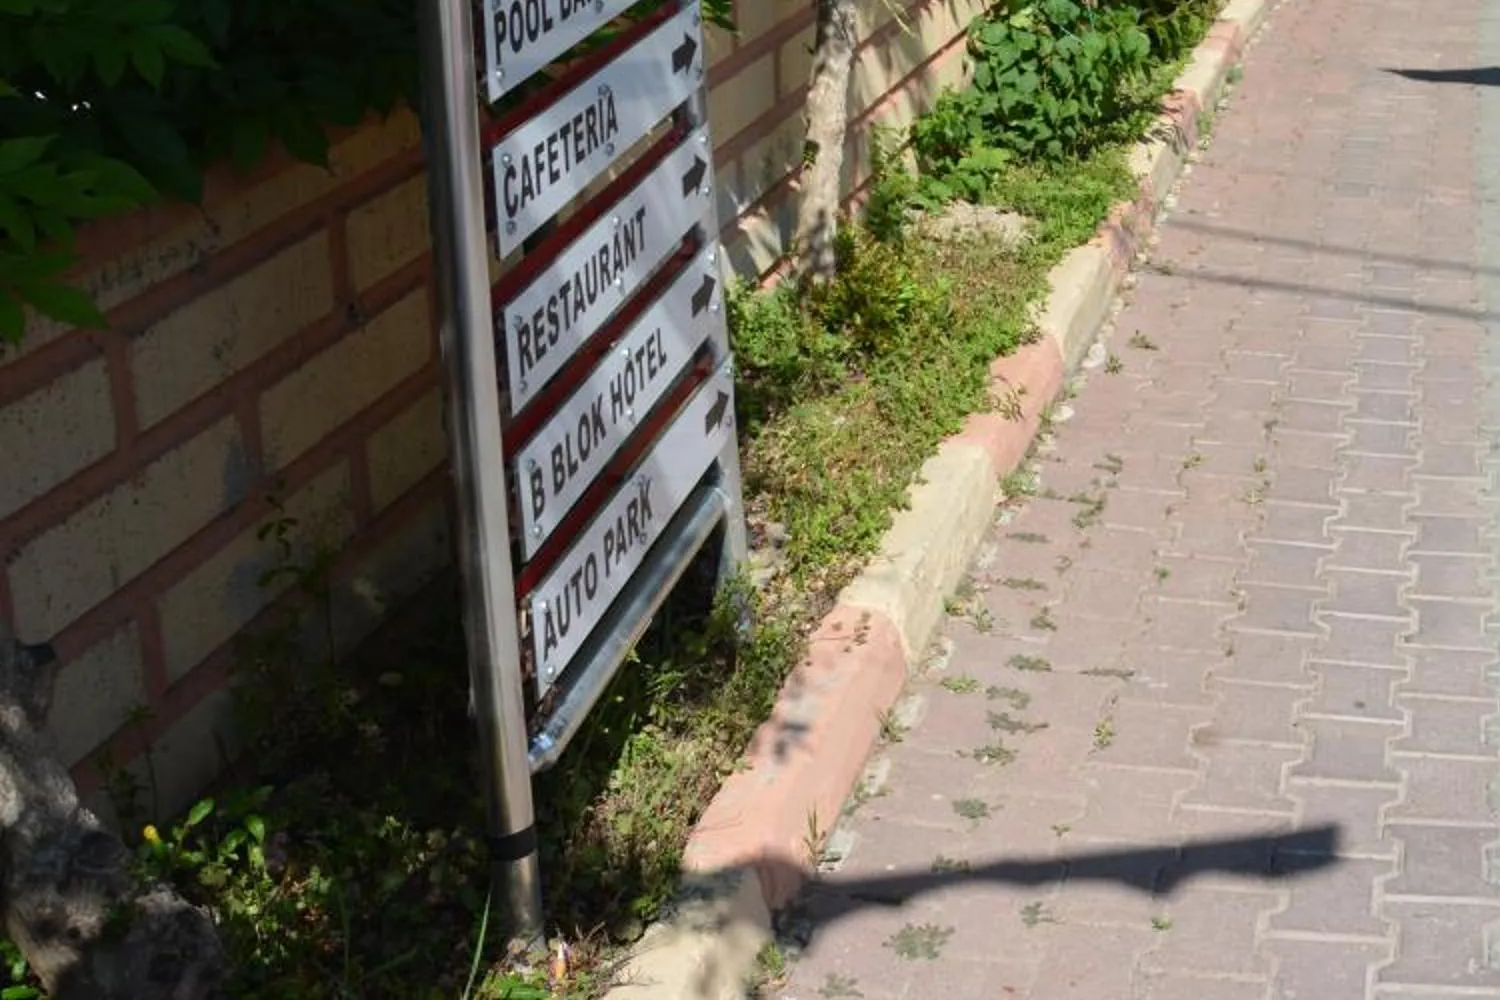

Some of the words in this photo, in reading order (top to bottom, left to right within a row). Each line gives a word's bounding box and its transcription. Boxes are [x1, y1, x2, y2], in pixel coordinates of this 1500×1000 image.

[503, 90, 619, 219] CAFETERIA
[517, 206, 646, 377] RESTAURANT
[530, 467, 545, 521] B
[551, 393, 607, 496] BLOK
[609, 327, 667, 425] HOTEL
[543, 551, 598, 662] AUTO
[603, 476, 654, 579] PARK
